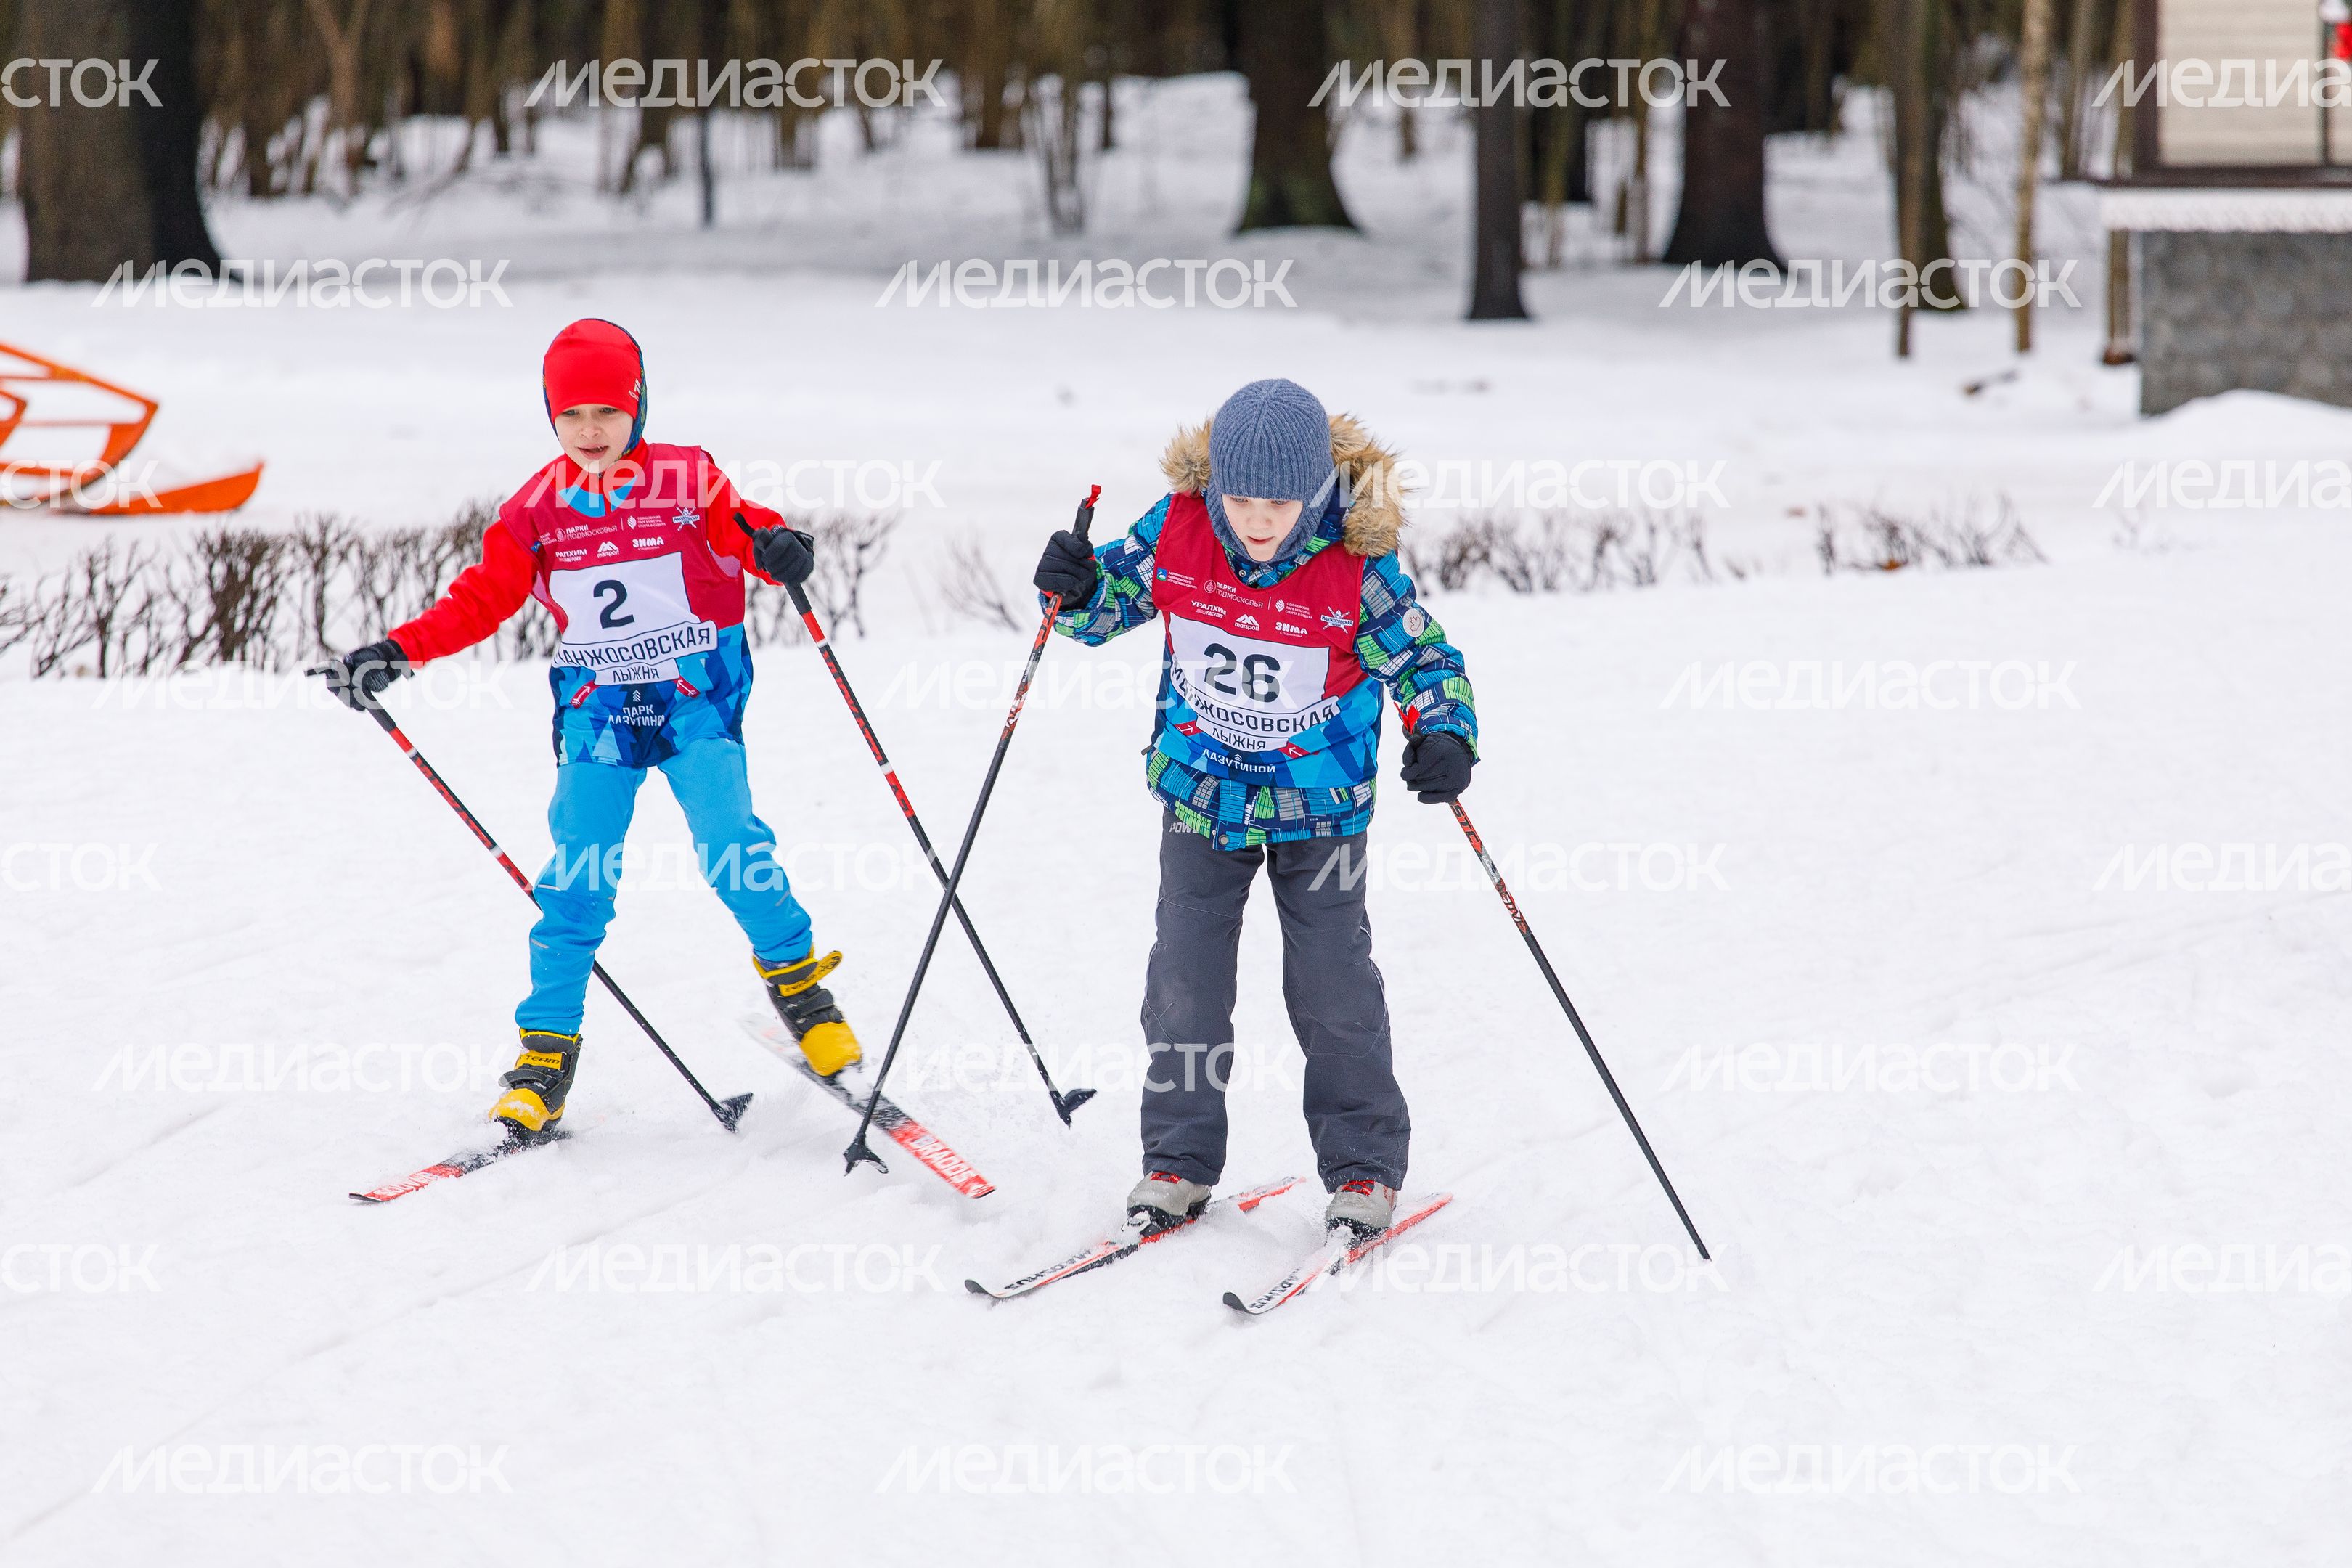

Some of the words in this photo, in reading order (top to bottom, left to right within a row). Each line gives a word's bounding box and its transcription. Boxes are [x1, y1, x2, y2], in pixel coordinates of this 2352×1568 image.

[565, 524, 589, 534] ПАРКИ
[566, 525, 618, 540] ПОДМОСКОВЬЯ
[632, 536, 664, 548] ЗИМА
[1216, 581, 1237, 593] ПАРКИ
[593, 580, 634, 629] 2
[1216, 588, 1264, 608] ПОДМОСКОВЬЯ
[1191, 600, 1227, 616] УРАЛХИМ
[1234, 622, 1259, 632] marsport
[1275, 621, 1308, 635] ЗИМА
[613, 666, 659, 683] ЛЫЖНЯ
[1204, 642, 1281, 703] 26
[623, 704, 654, 718] ПАРК
[1213, 727, 1266, 750] ЛЫЖНЯ
[1203, 748, 1275, 773] ЛАЗУТИНОЙ
[1452, 804, 1481, 844] STC
